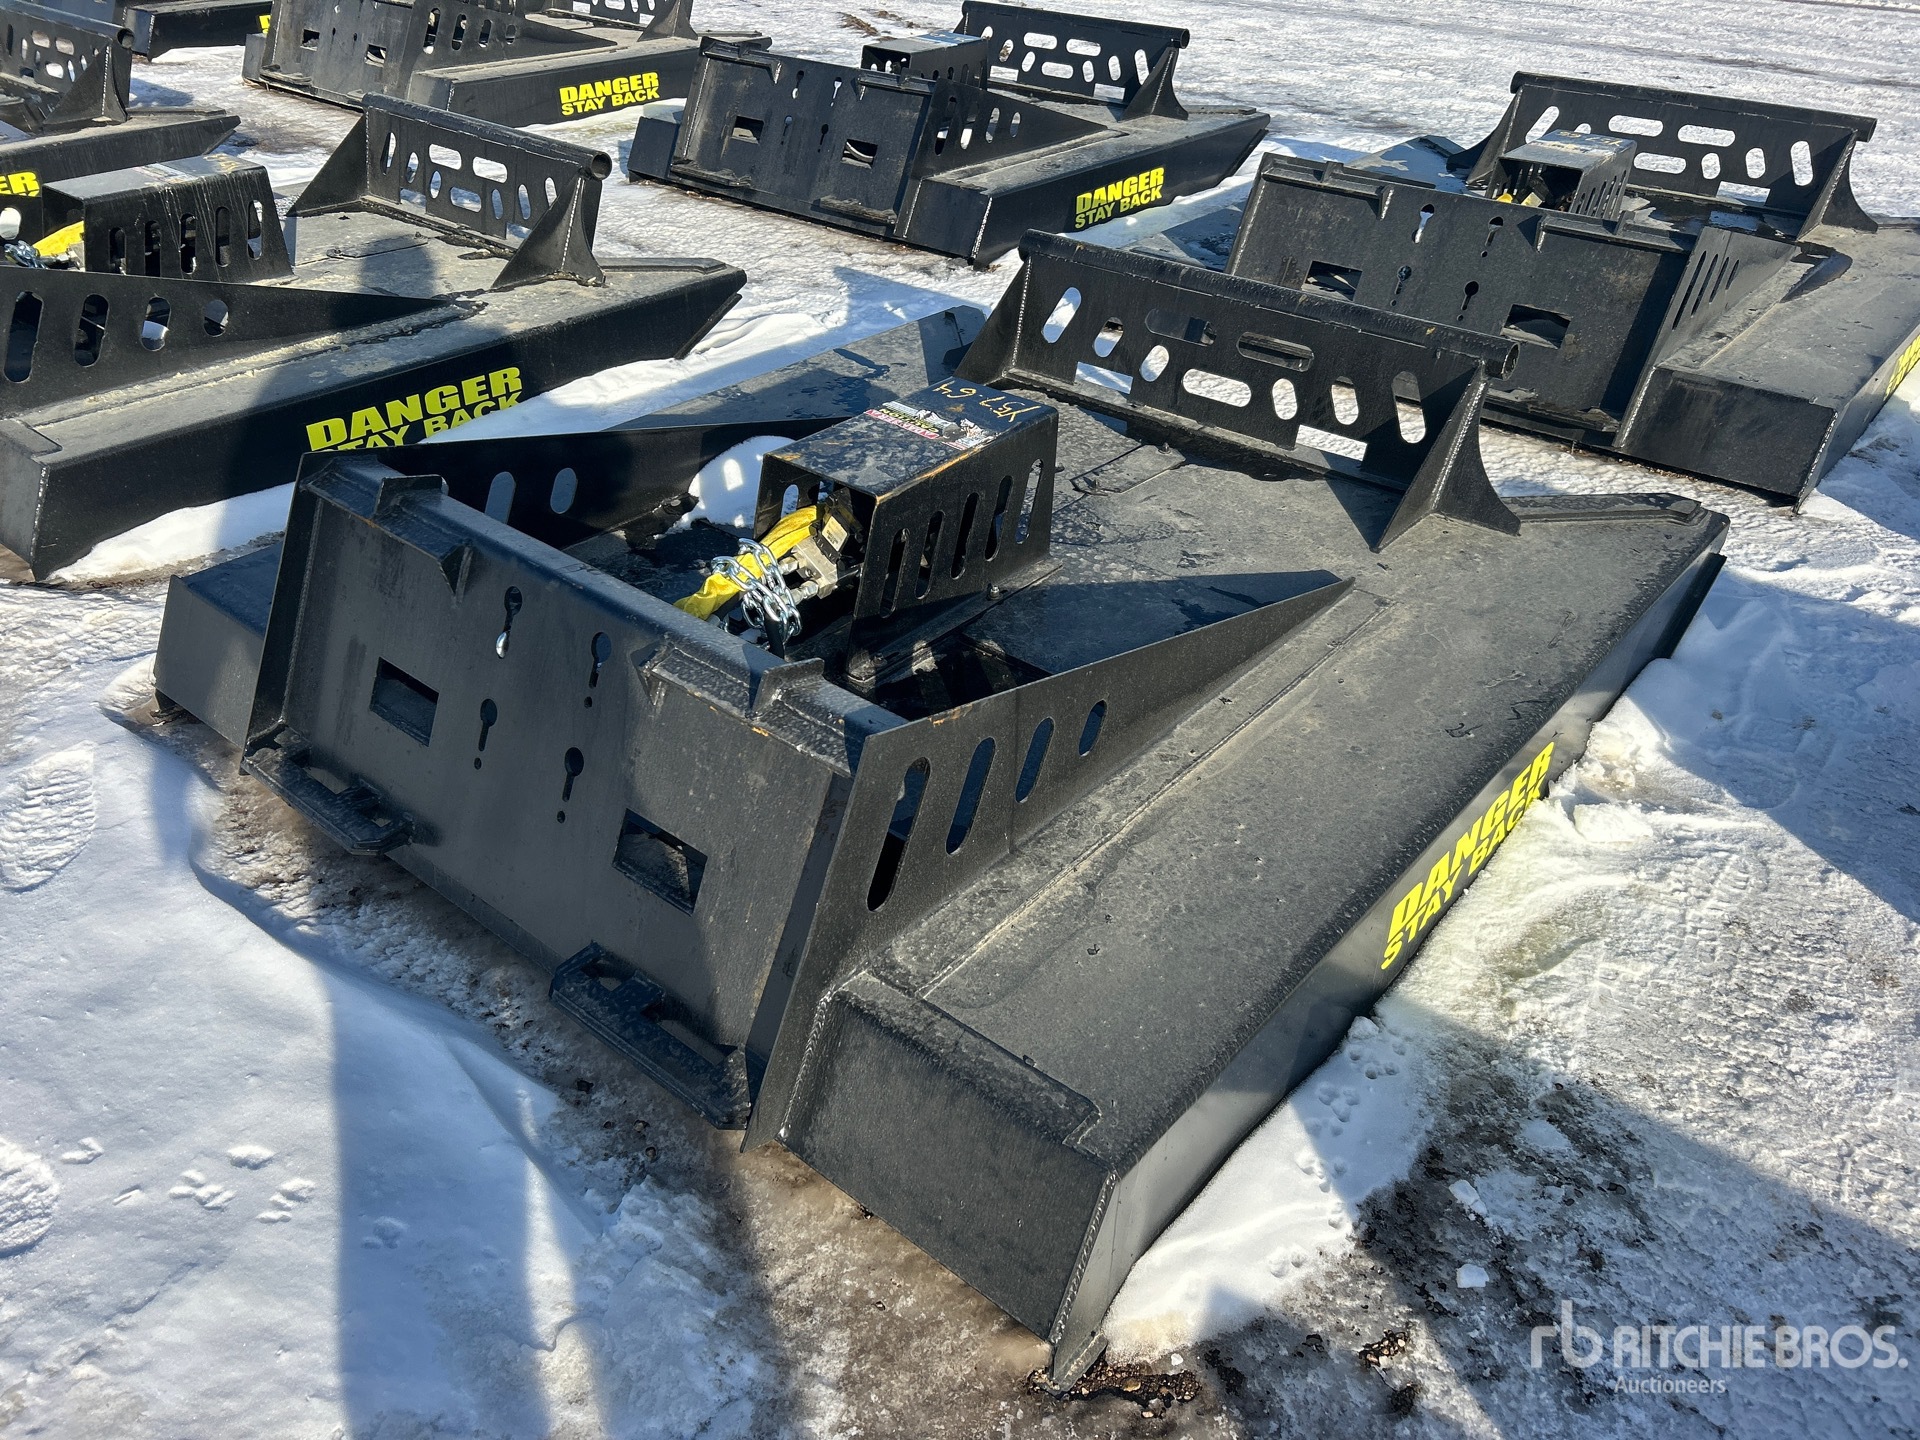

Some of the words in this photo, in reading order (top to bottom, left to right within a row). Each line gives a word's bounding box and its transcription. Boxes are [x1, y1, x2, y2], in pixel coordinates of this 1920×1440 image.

[560, 72, 659, 104] DANGER
[561, 96, 606, 116] STAY
[611, 87, 660, 107] BACK
[1075, 202, 1116, 229] STAY
[1119, 185, 1163, 213] BACK
[1076, 167, 1165, 215] DANGER
[306, 366, 522, 451] DANGER
[1387, 741, 1554, 943] DANGER
[1380, 864, 1464, 970] STAY
[1468, 774, 1546, 877] BACK
